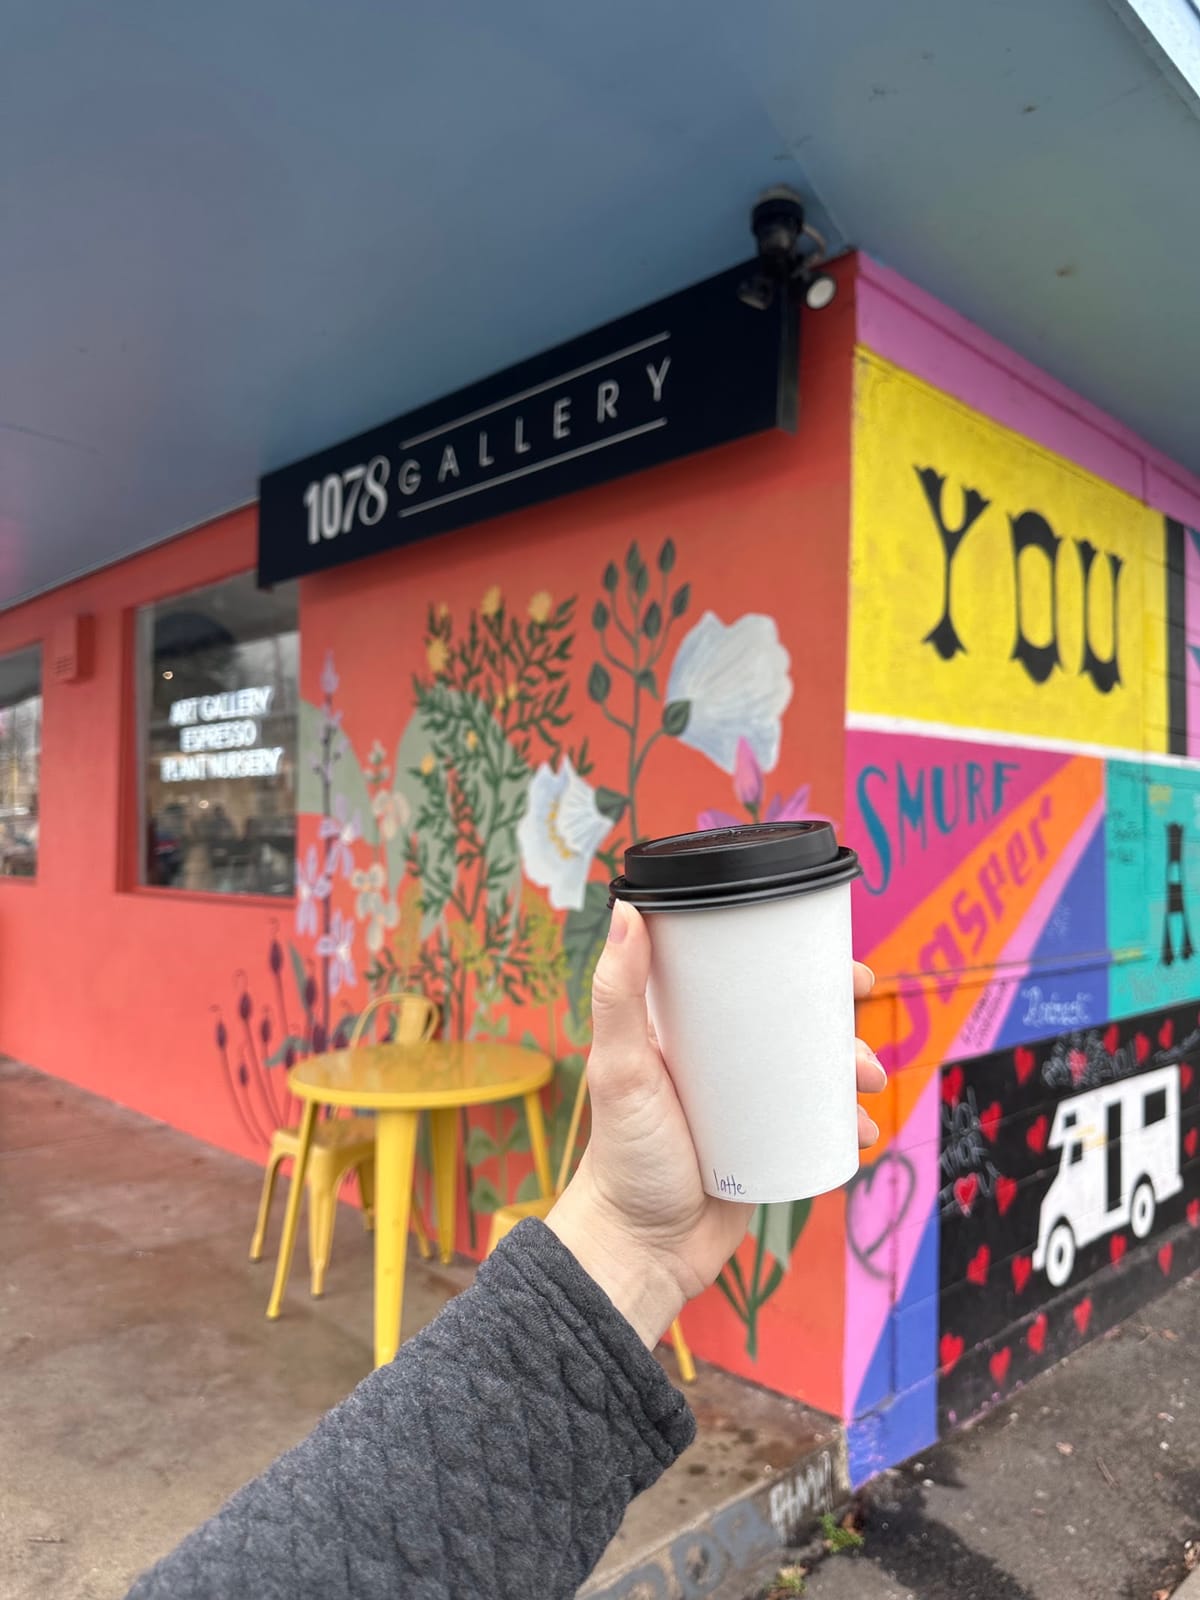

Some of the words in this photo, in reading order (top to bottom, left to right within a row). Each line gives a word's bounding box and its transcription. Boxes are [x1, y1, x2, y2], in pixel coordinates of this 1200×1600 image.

[304, 455, 391, 544] 1078
[398, 356, 672, 496] GALLERY
[199, 685, 273, 722] GALLERY
[180, 719, 257, 753] ESPRESSO
[160, 753, 207, 783] PLANT
[207, 747, 283, 778] NURSERY
[856, 760, 1021, 895] SMURF
[713, 1168, 746, 1196] latte
